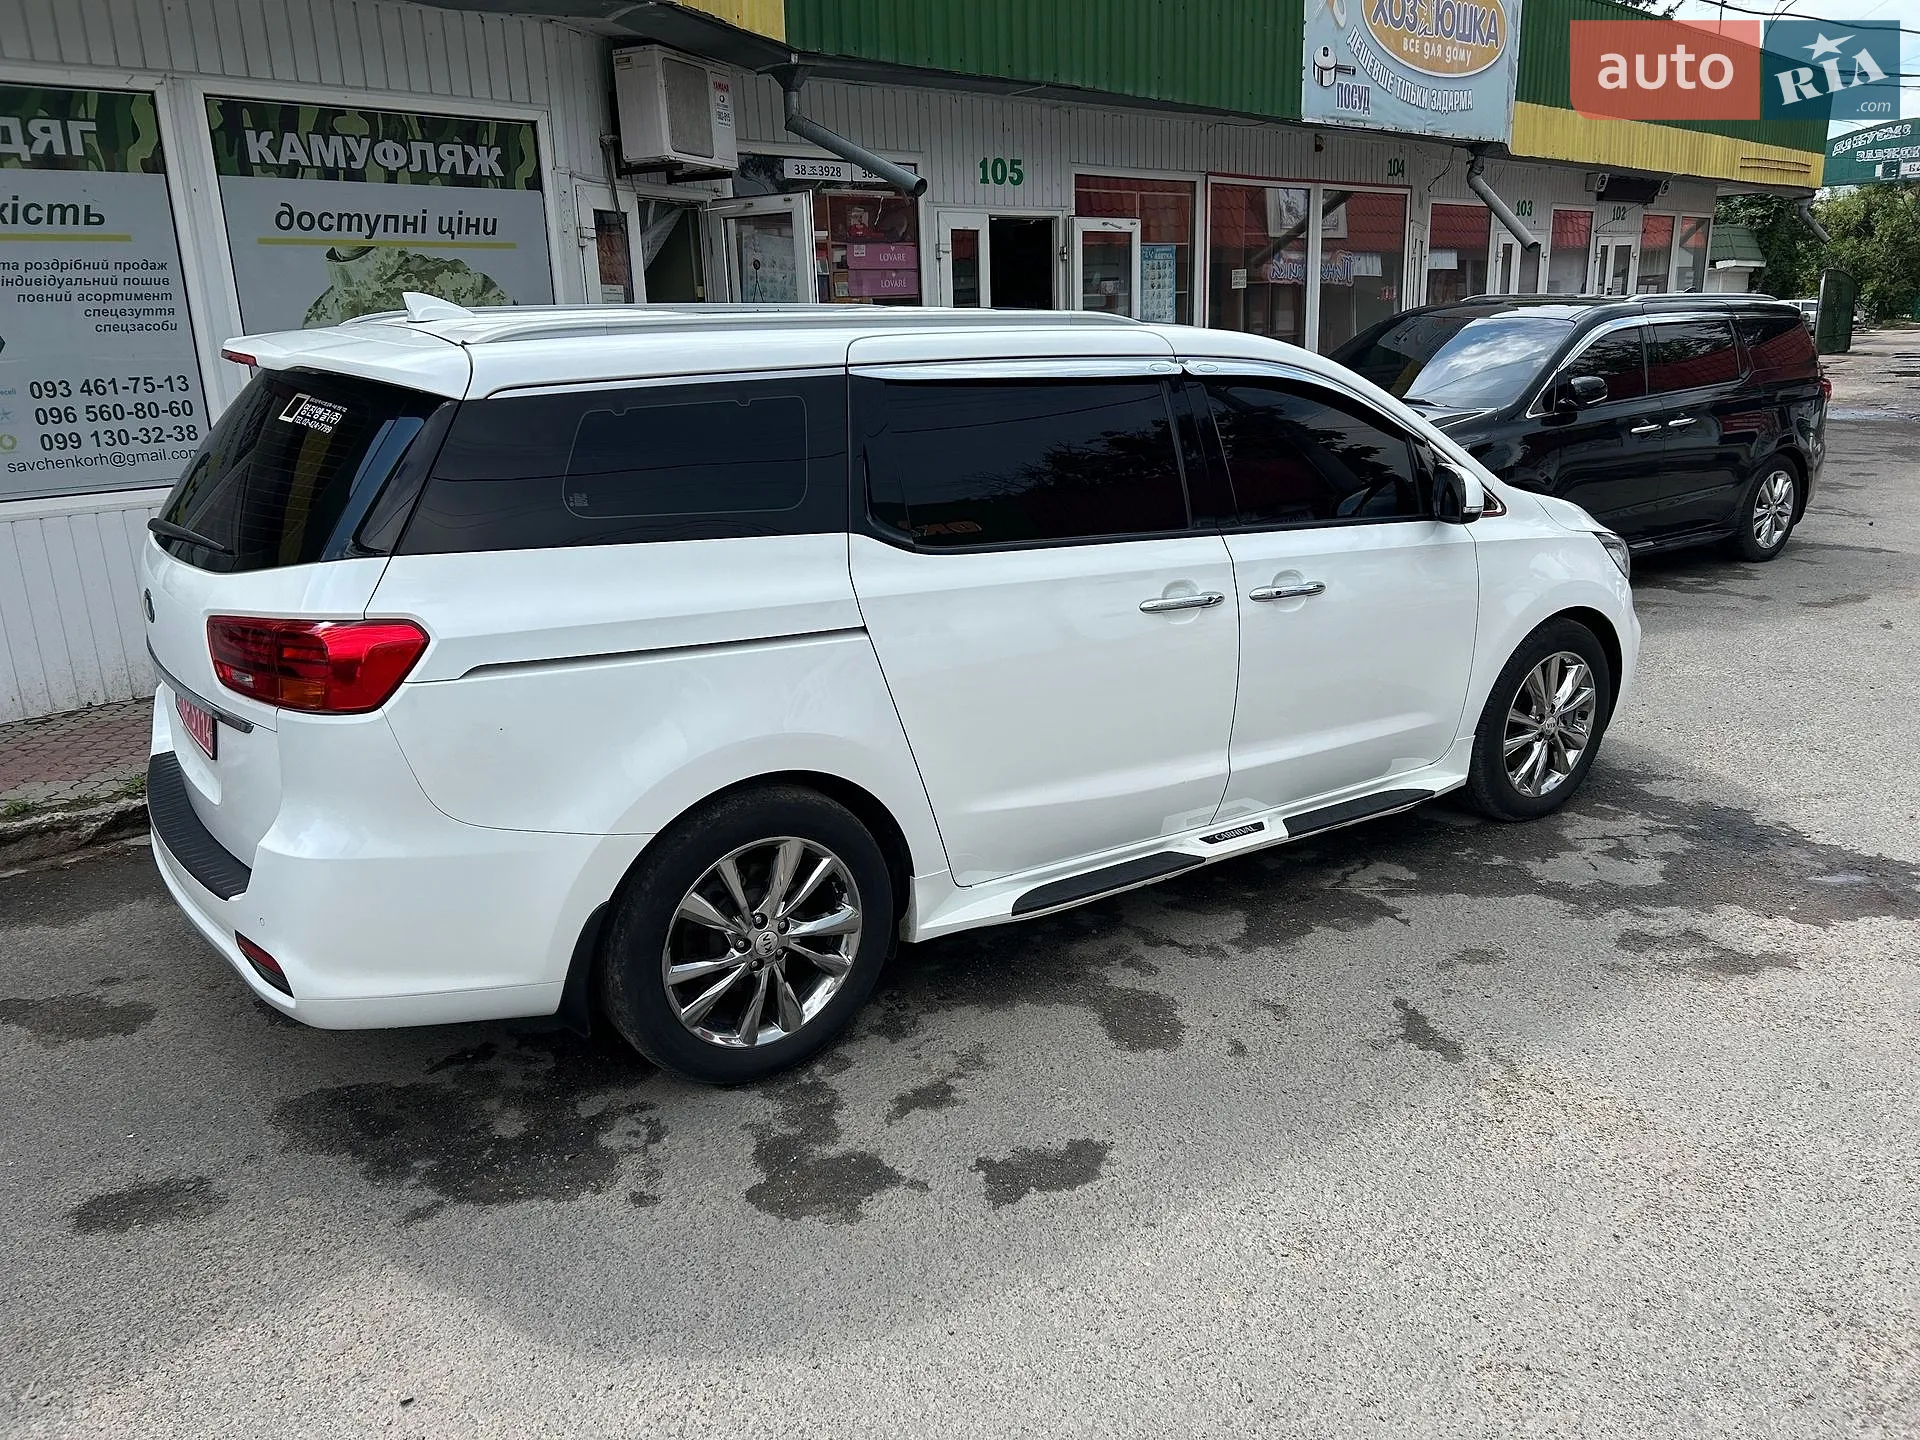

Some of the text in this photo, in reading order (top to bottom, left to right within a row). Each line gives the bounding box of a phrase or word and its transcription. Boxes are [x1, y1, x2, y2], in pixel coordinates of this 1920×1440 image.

[1402, 38, 1420, 53] ВСЕ
[1445, 46, 1472, 67] дому
[1346, 25, 1473, 115] ДЕШЕВШЕ ТІЛЬКИ ЗАДАРМА
[1336, 82, 1371, 116] ПОСУД
[245, 130, 504, 177] КАМУФЛЯЖ
[794, 164, 842, 178] 38조3928
[979, 157, 1024, 186] 105
[1388, 158, 1405, 177] 104
[1516, 200, 1533, 217] 103
[1612, 206, 1626, 221] 102
[275, 203, 498, 240] доступні ціни
[25, 259, 109, 273] роздрібний
[114, 259, 168, 272] продаж
[1, 275, 170, 289] індивідуальний пошив
[17, 291, 173, 304] повний асортимент
[84, 306, 175, 320] спецвзуття
[95, 320, 178, 334] спецзасоби
[29, 375, 190, 399] 093 461-75-13
[35, 400, 194, 425] 096 560-80-60
[40, 424, 199, 451] 099 130-32-38
[1214, 825, 1258, 841] CARNIVAL
